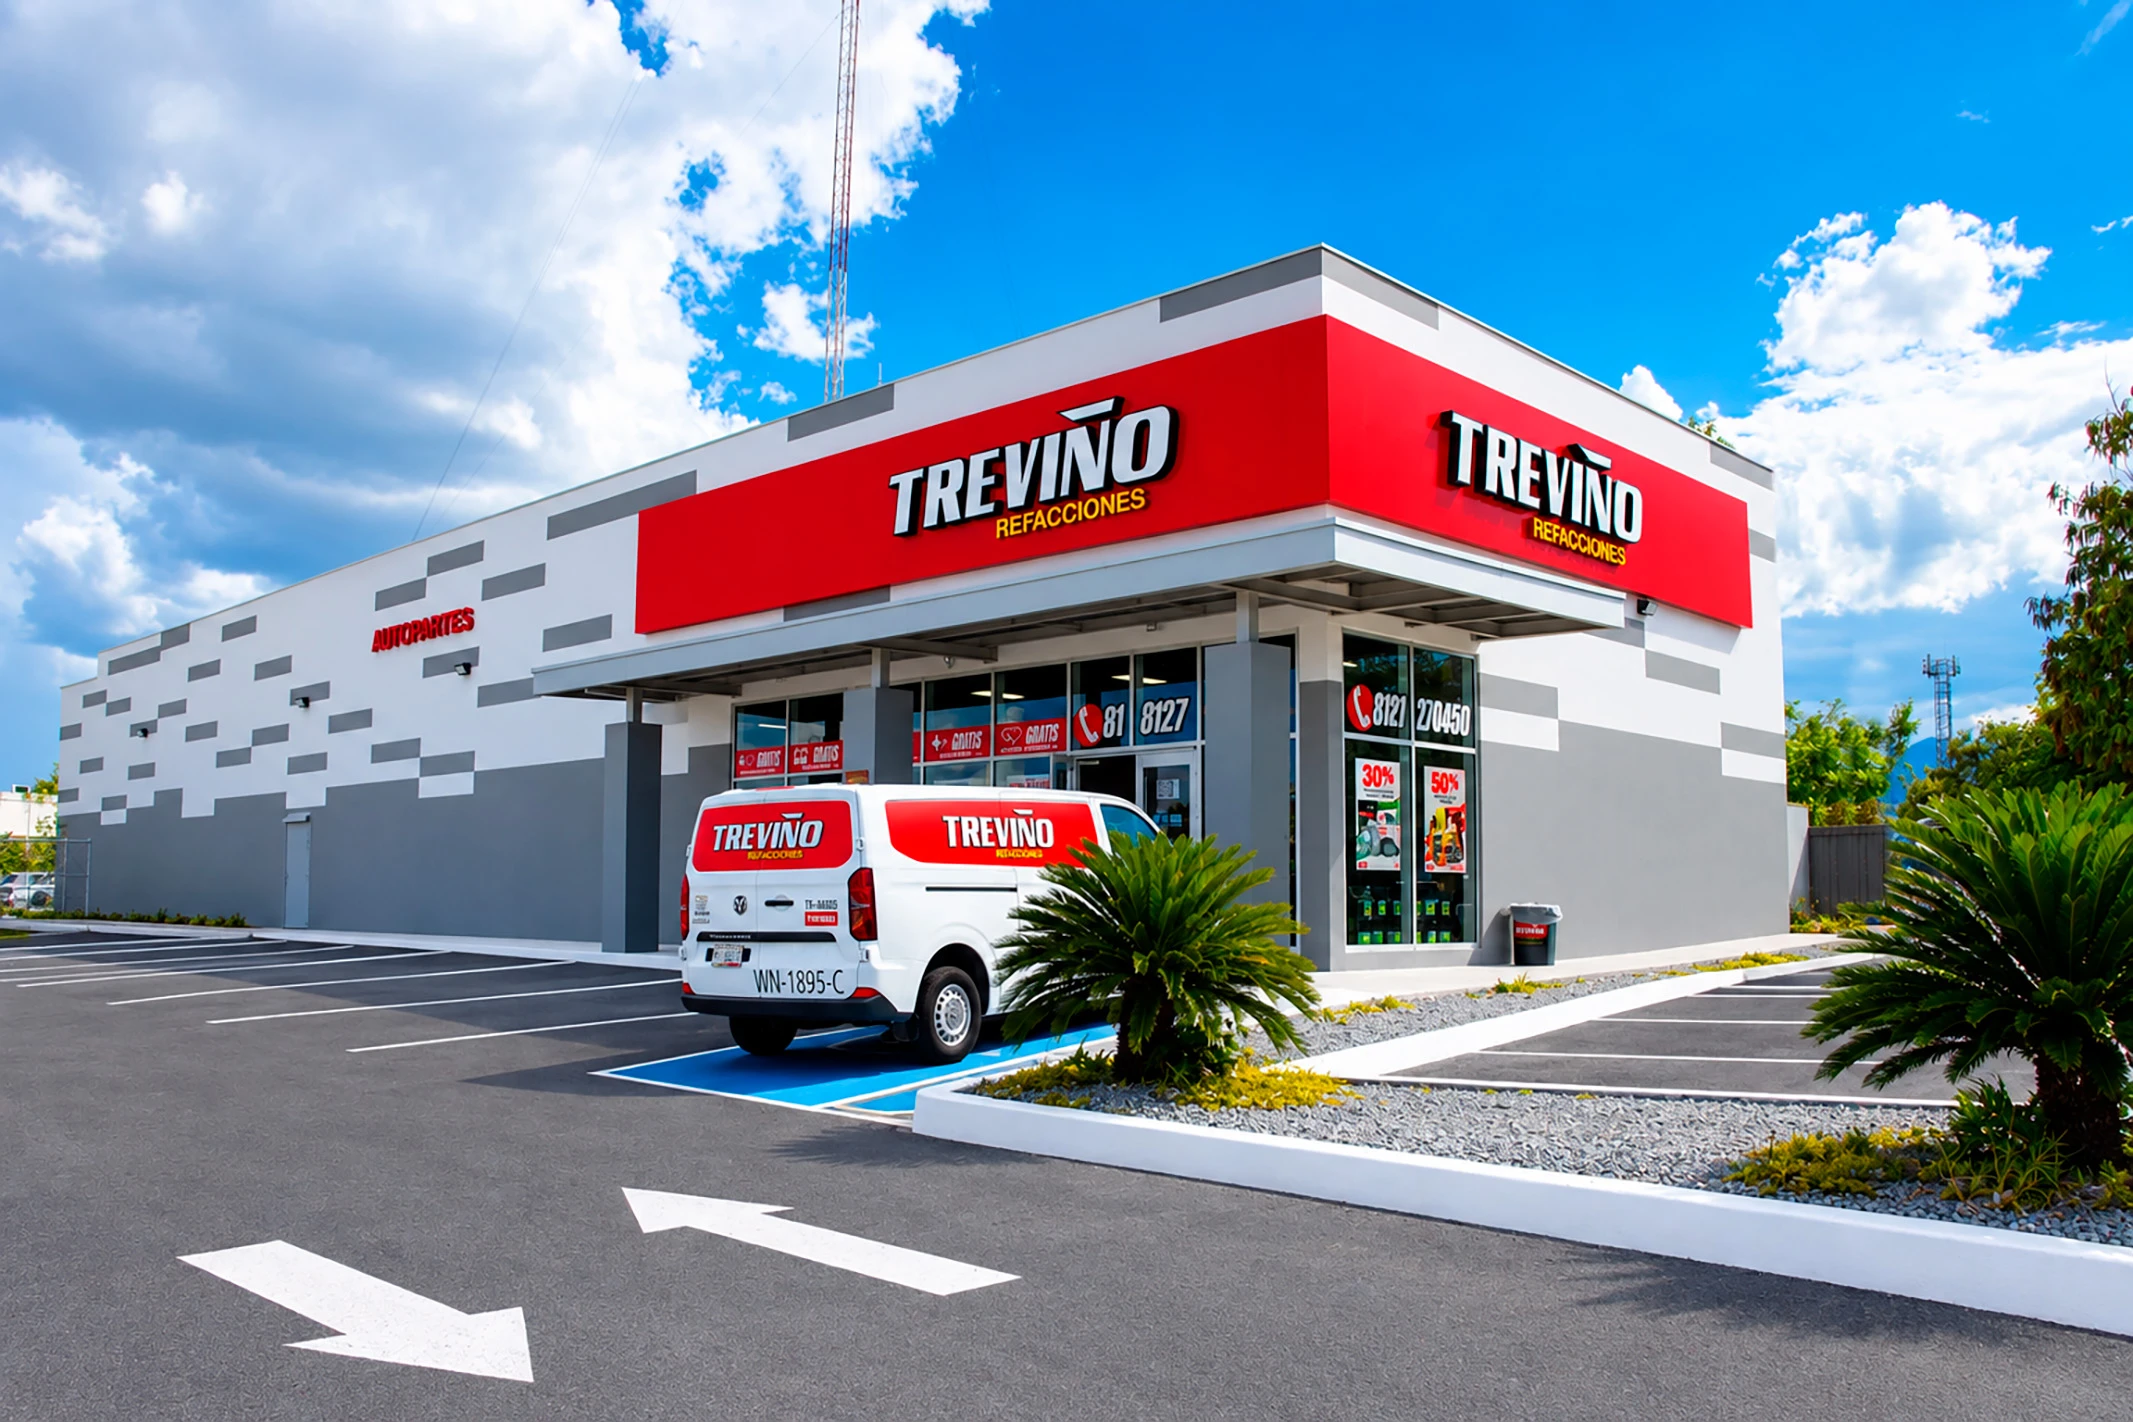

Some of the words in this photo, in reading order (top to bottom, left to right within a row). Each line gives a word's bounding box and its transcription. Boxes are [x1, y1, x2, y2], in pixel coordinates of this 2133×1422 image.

[888, 396, 1177, 536] TREVIÑO
[1444, 410, 1643, 544] TREVIÑO
[996, 488, 1146, 539] REFACCIONES
[1532, 517, 1626, 566] REFACCIONES
[371, 606, 475, 653] AUTOPARTES
[1103, 703, 1125, 738] 81
[1140, 698, 1189, 735] 8127
[1416, 698, 1470, 736] 270450
[1362, 763, 1395, 788] 30%
[1431, 770, 1459, 795] 50%
[713, 812, 824, 851] TREVIÑO
[942, 808, 1055, 848] TREVIÑO
[753, 969, 845, 994] WN-1895-C
